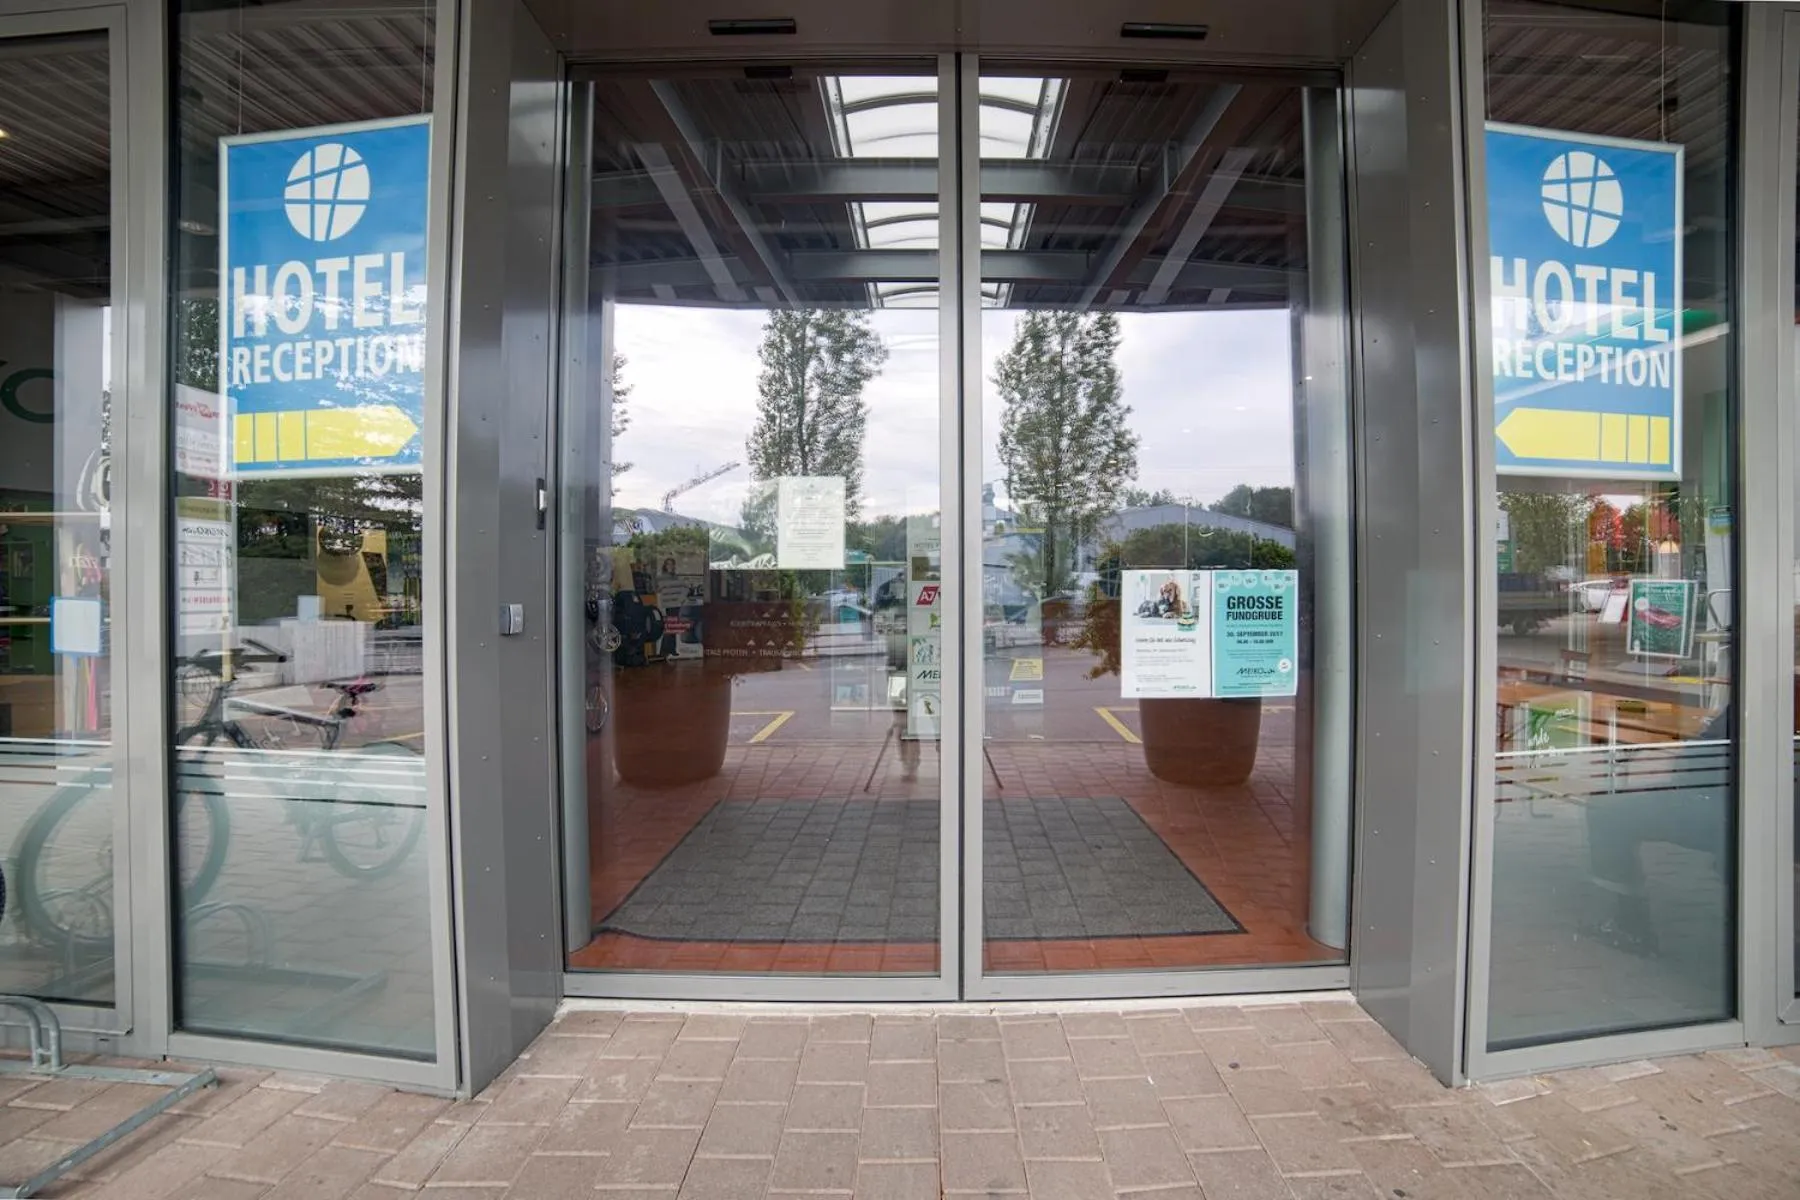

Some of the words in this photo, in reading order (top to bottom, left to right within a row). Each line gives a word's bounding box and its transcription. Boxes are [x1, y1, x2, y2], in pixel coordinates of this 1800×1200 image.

[233, 252, 420, 339] HOTEL
[1490, 256, 1669, 342] HOTEL
[233, 335, 424, 385] RECEPTION
[1492, 338, 1670, 388] RECEPTION
[1226, 611, 1283, 621] FUNDGRUBE
[1227, 595, 1283, 610] GROSSE
